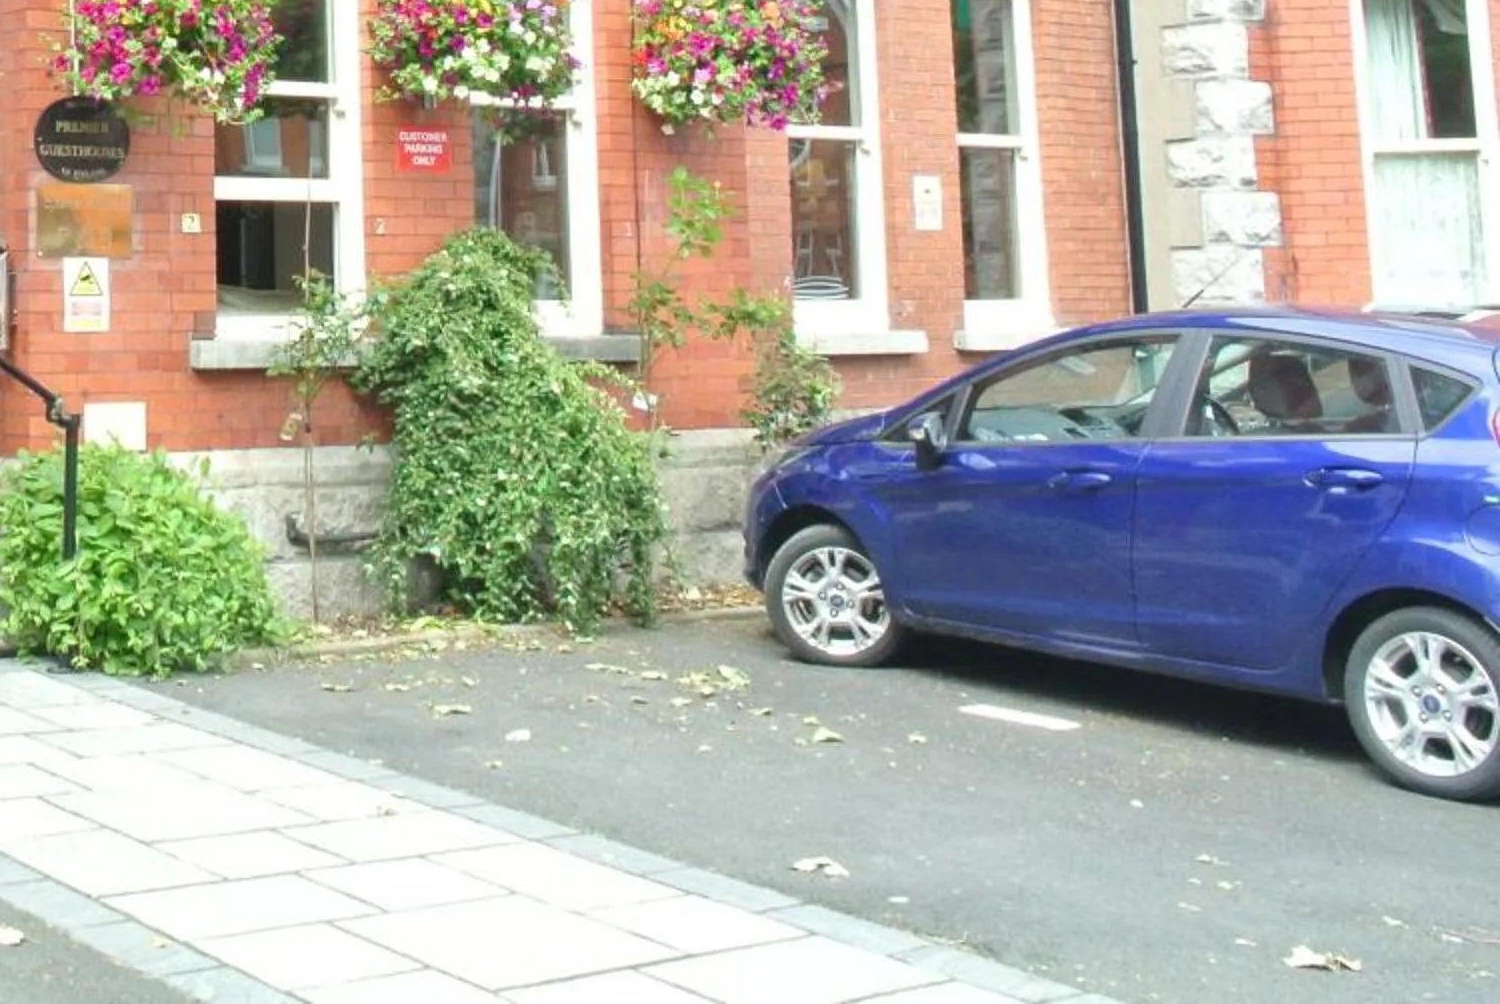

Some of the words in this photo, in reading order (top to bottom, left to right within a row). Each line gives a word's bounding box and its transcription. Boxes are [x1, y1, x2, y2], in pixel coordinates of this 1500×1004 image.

[55, 120, 109, 133] PREMIER
[399, 131, 447, 141] CUSTOMER
[404, 143, 442, 154] PARKING
[412, 156, 436, 165] ONLY
